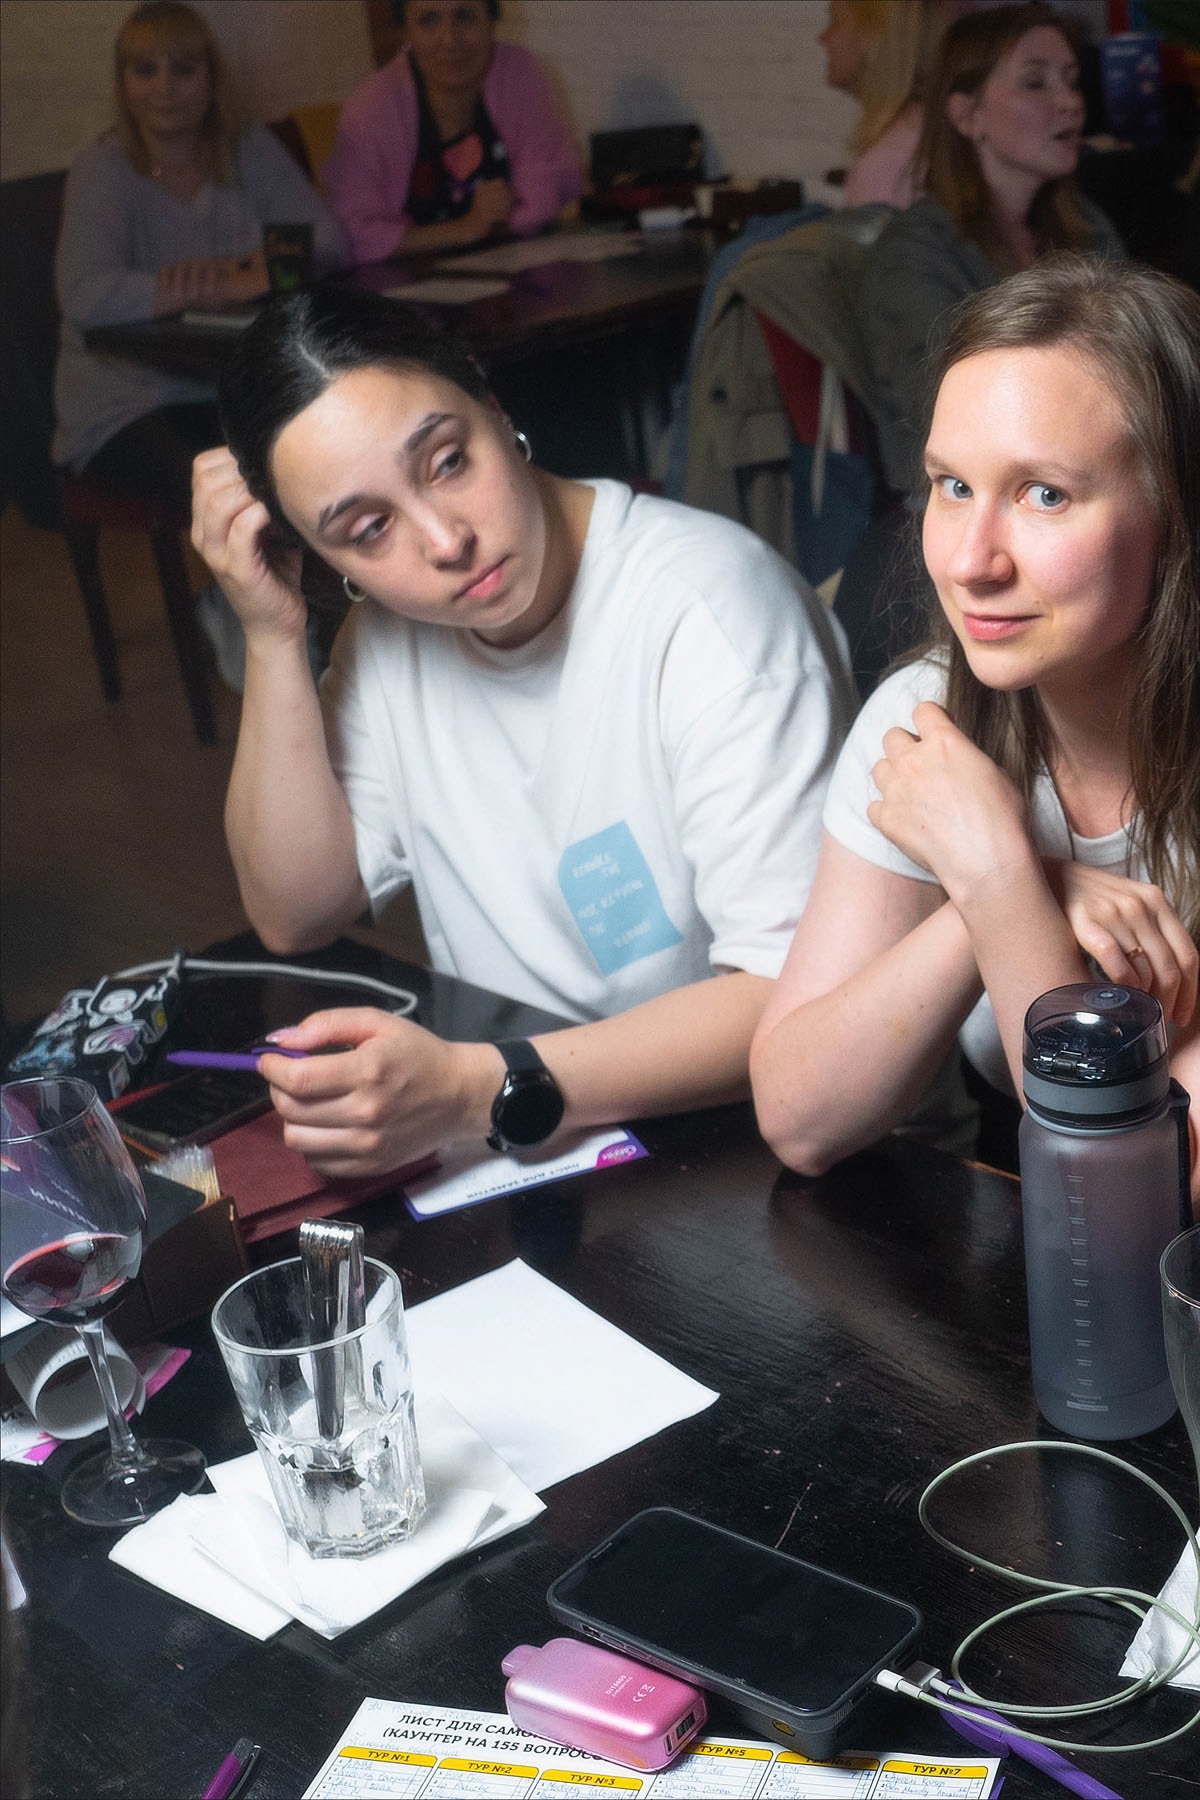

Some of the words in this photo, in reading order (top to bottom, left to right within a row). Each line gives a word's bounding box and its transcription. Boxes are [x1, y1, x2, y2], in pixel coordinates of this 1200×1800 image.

[398, 1714, 446, 1728] ЛИСТ
[445, 1719, 483, 1732] ДЛЯ
[485, 1724, 538, 1738] САМО
[382, 1727, 462, 1743] (КАУНТЕР
[465, 1736, 487, 1748] НА
[491, 1739, 520, 1751] 155
[368, 1750, 391, 1759] ТУР
[391, 1754, 411, 1762] №1
[699, 1745, 723, 1753] ТУР
[725, 1748, 747, 1757] №5
[468, 1762, 490, 1771] ТУР
[491, 1766, 513, 1774] №2
[913, 1765, 937, 1773] ТУР
[939, 1768, 962, 1776] №7
[570, 1774, 593, 1782] ТУР
[595, 1777, 616, 1786] №3
